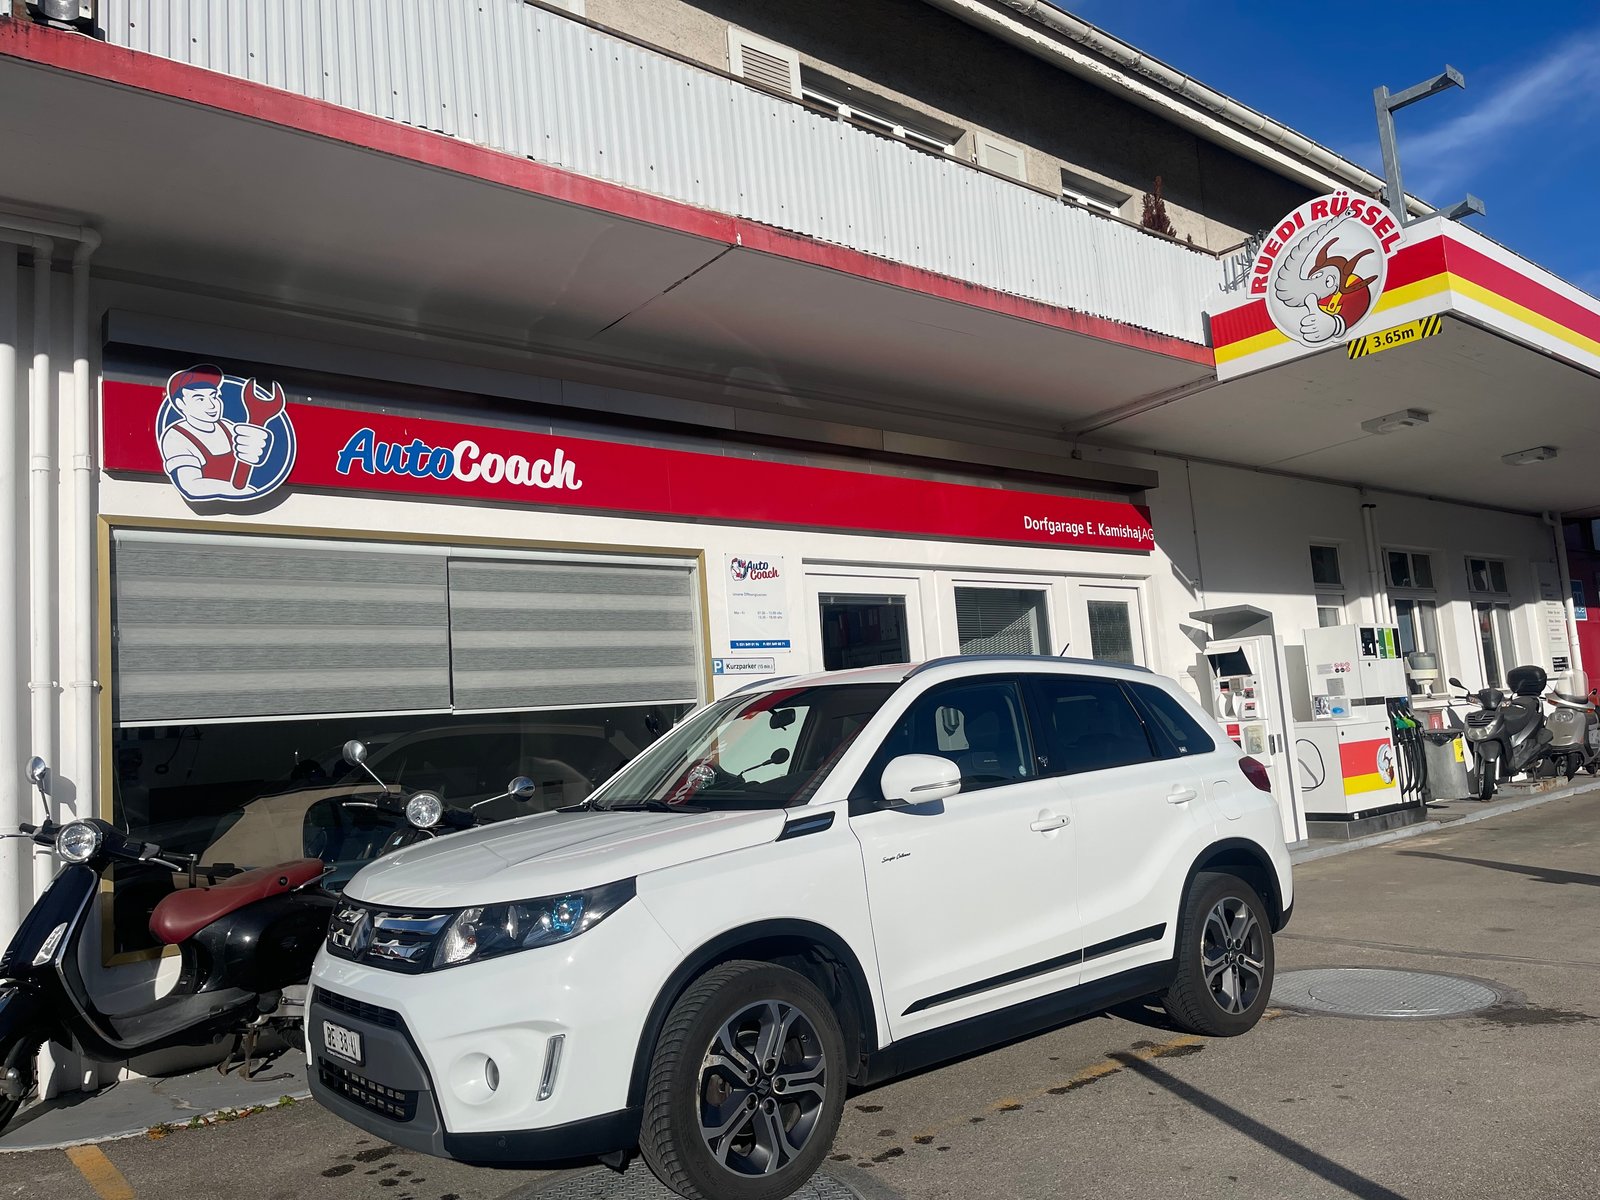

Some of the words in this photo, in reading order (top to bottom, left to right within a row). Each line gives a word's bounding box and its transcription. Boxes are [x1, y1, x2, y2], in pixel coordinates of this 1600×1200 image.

[1251, 211, 1306, 294] RUEDI
[1311, 190, 1401, 255] RÜSSEL
[1373, 328, 1415, 348] 3.65m
[1023, 515, 1084, 537] Dorfgarage
[1086, 521, 1096, 535] E.
[746, 560, 769, 573] Auto
[750, 567, 780, 580] Coach
[1368, 643, 1374, 654] 1
[326, 1026, 336, 1048] BE
